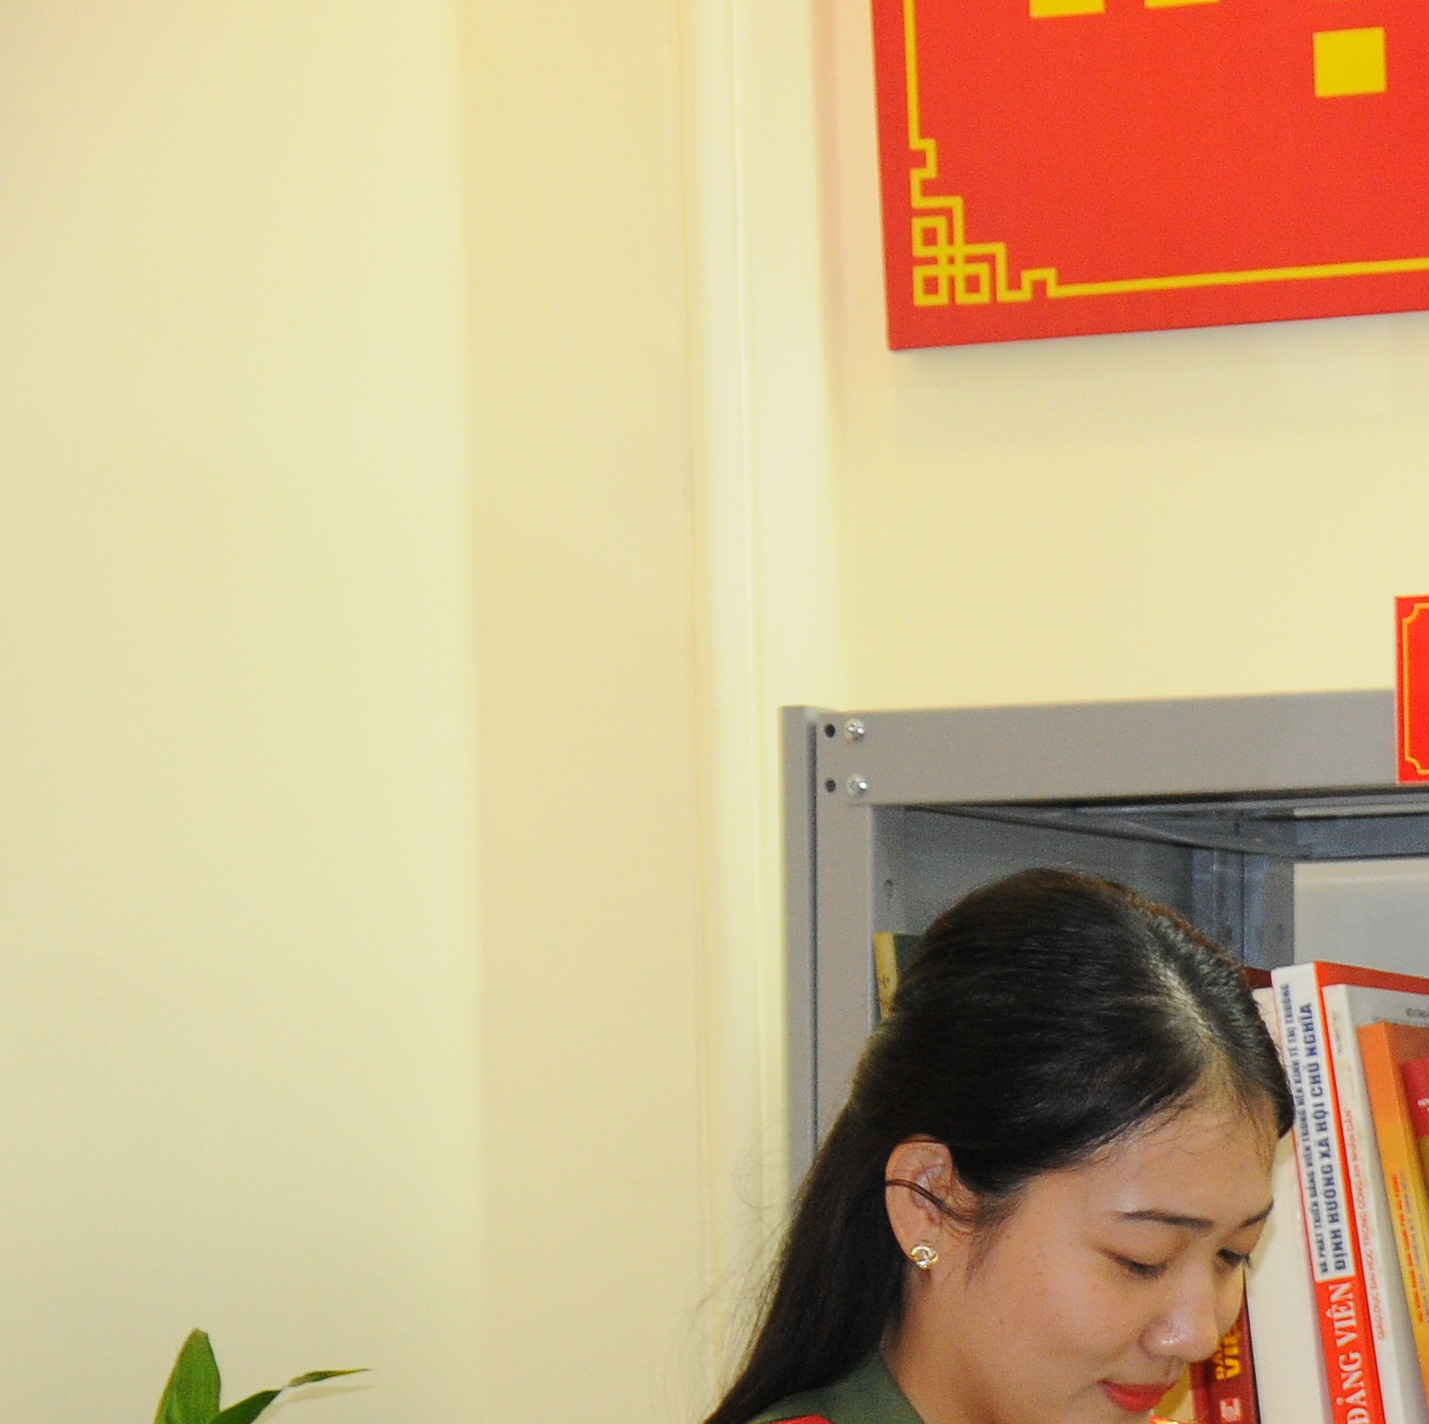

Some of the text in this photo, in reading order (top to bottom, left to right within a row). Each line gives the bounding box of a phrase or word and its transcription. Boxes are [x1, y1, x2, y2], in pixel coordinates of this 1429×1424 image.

[1298, 1001, 1349, 1270] ĐỊNH HƯỚNG XÃ HỘI CHỦ NGHĨA
[1326, 1281, 1360, 1347] VIÊN
